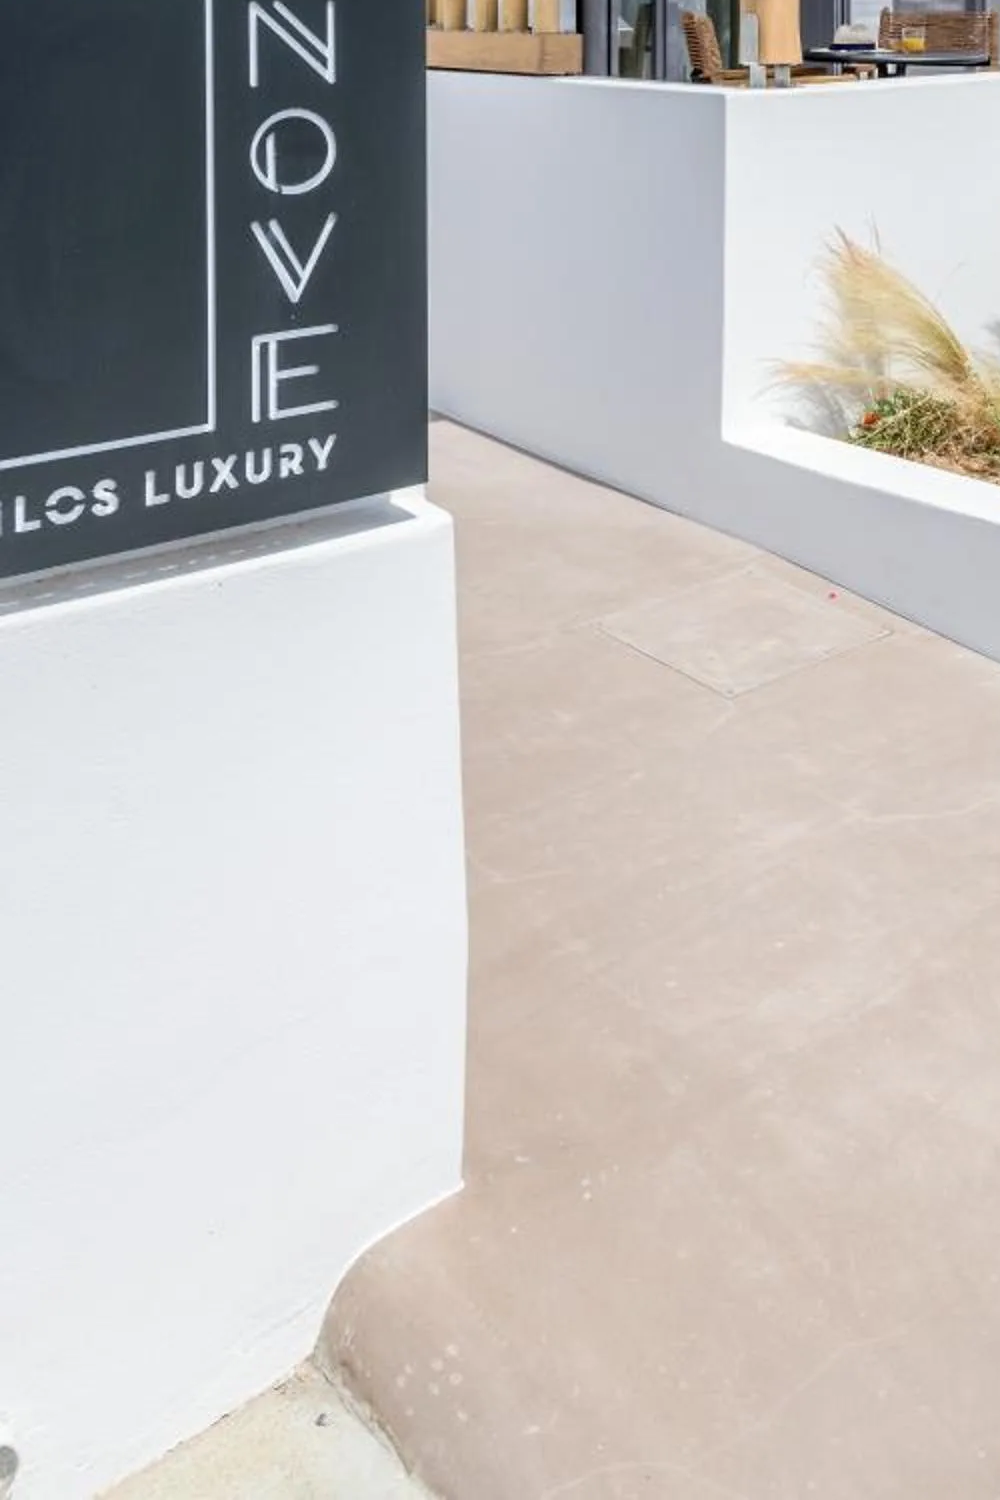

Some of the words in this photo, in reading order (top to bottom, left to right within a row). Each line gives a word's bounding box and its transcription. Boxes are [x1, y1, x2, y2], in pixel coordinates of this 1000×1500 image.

[249, 0, 338, 424] NOVE
[0, 479, 120, 537] LOS
[145, 433, 337, 507] LUXURY
